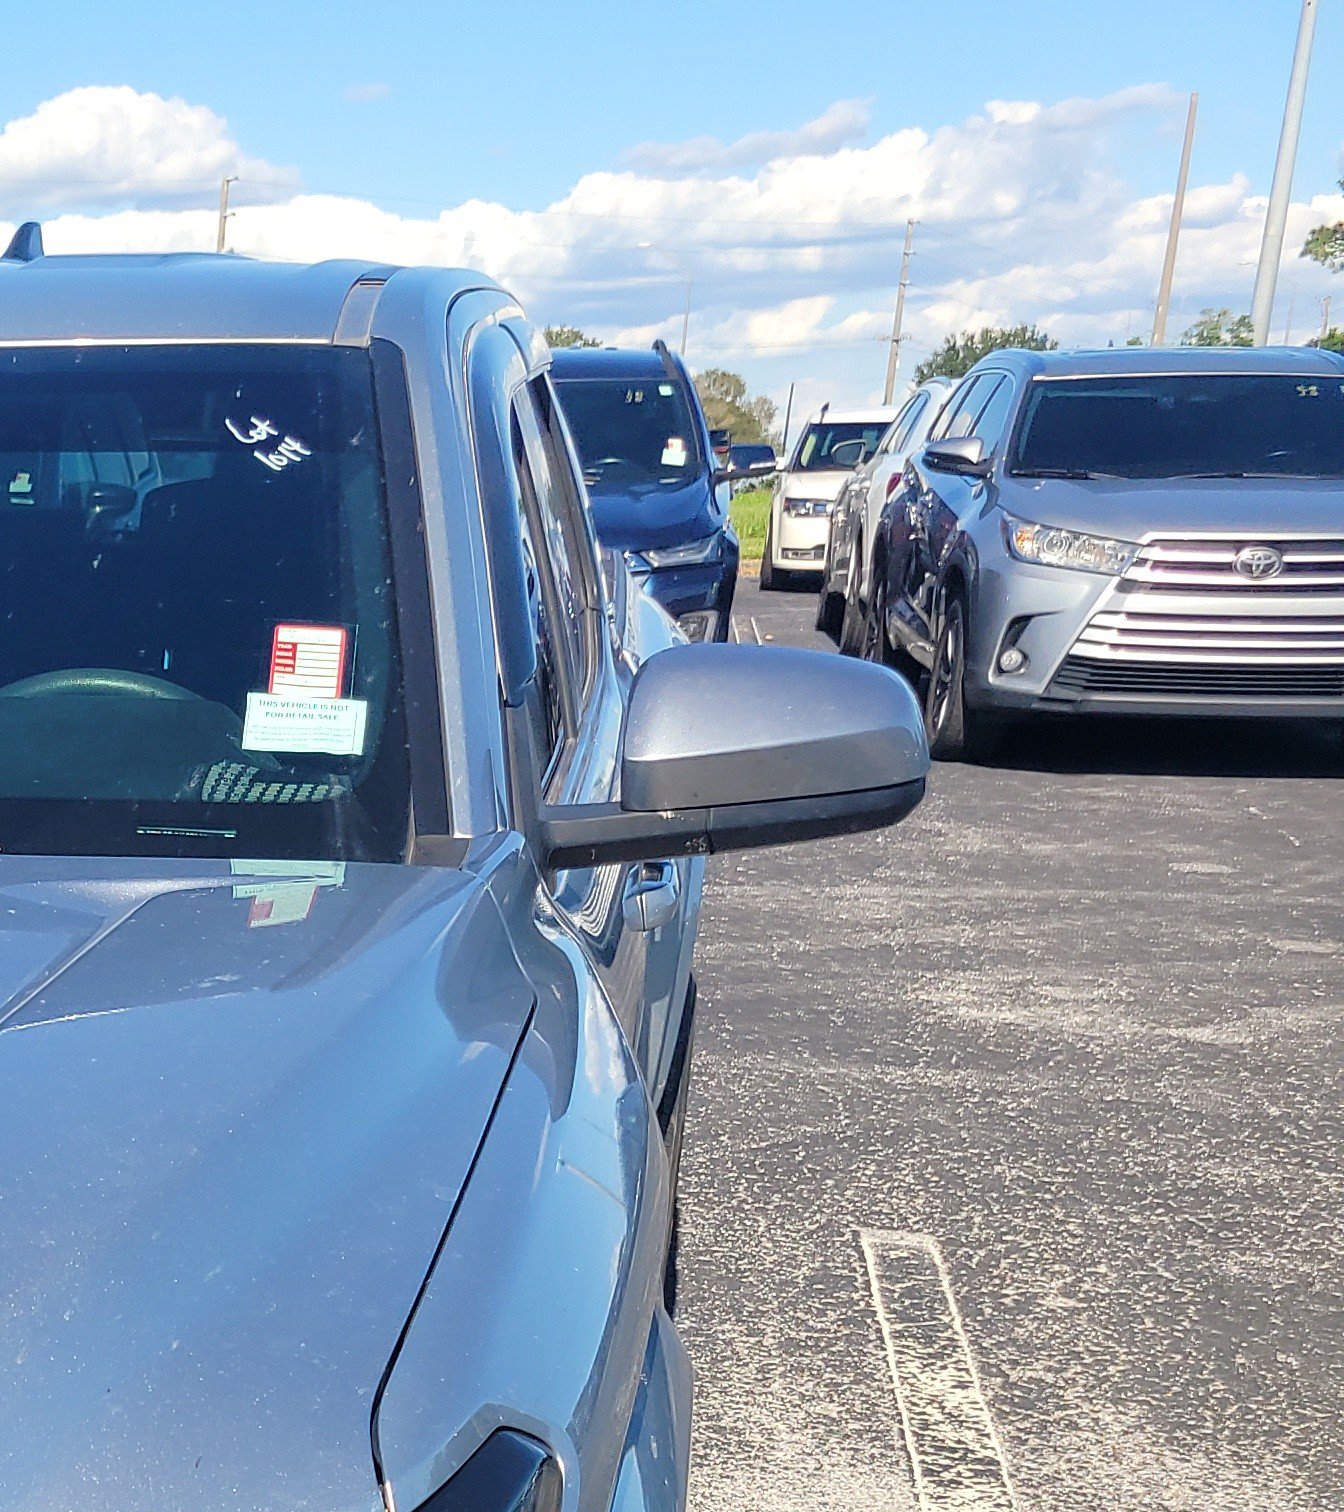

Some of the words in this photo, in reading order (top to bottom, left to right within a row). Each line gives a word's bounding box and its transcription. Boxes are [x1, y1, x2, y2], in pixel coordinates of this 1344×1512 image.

[259, 699, 278, 708] THIS
[280, 701, 318, 710] VEHICLE
[330, 704, 349, 712] NOT
[285, 712, 315, 720] RETAIL
[317, 713, 339, 721] SALE
